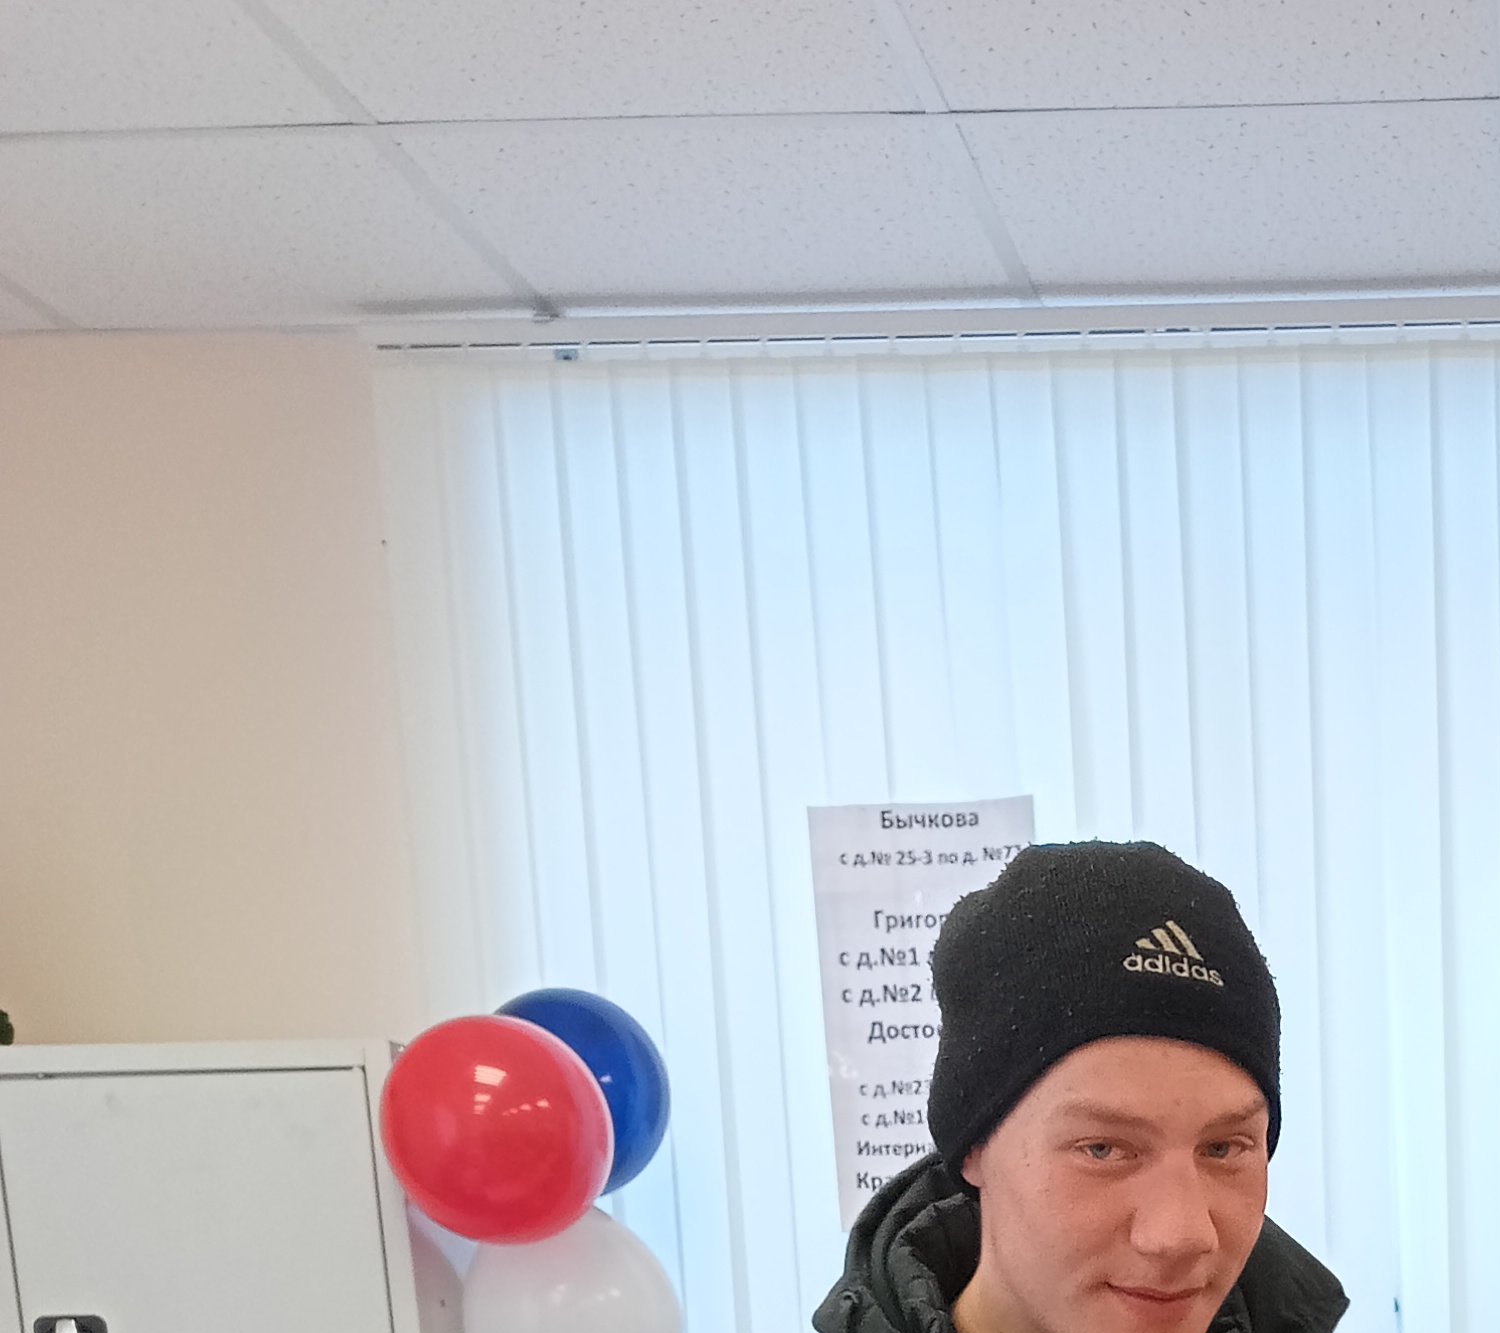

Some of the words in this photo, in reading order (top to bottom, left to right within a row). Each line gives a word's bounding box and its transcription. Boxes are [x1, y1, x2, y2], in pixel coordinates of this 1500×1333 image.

[880, 810, 980, 829] Бычкова
[937, 853, 958, 865] по
[839, 951, 849, 967] с
[1123, 953, 1224, 987] adidas
[842, 988, 852, 1003] с
[856, 1172, 894, 1192] Кр
